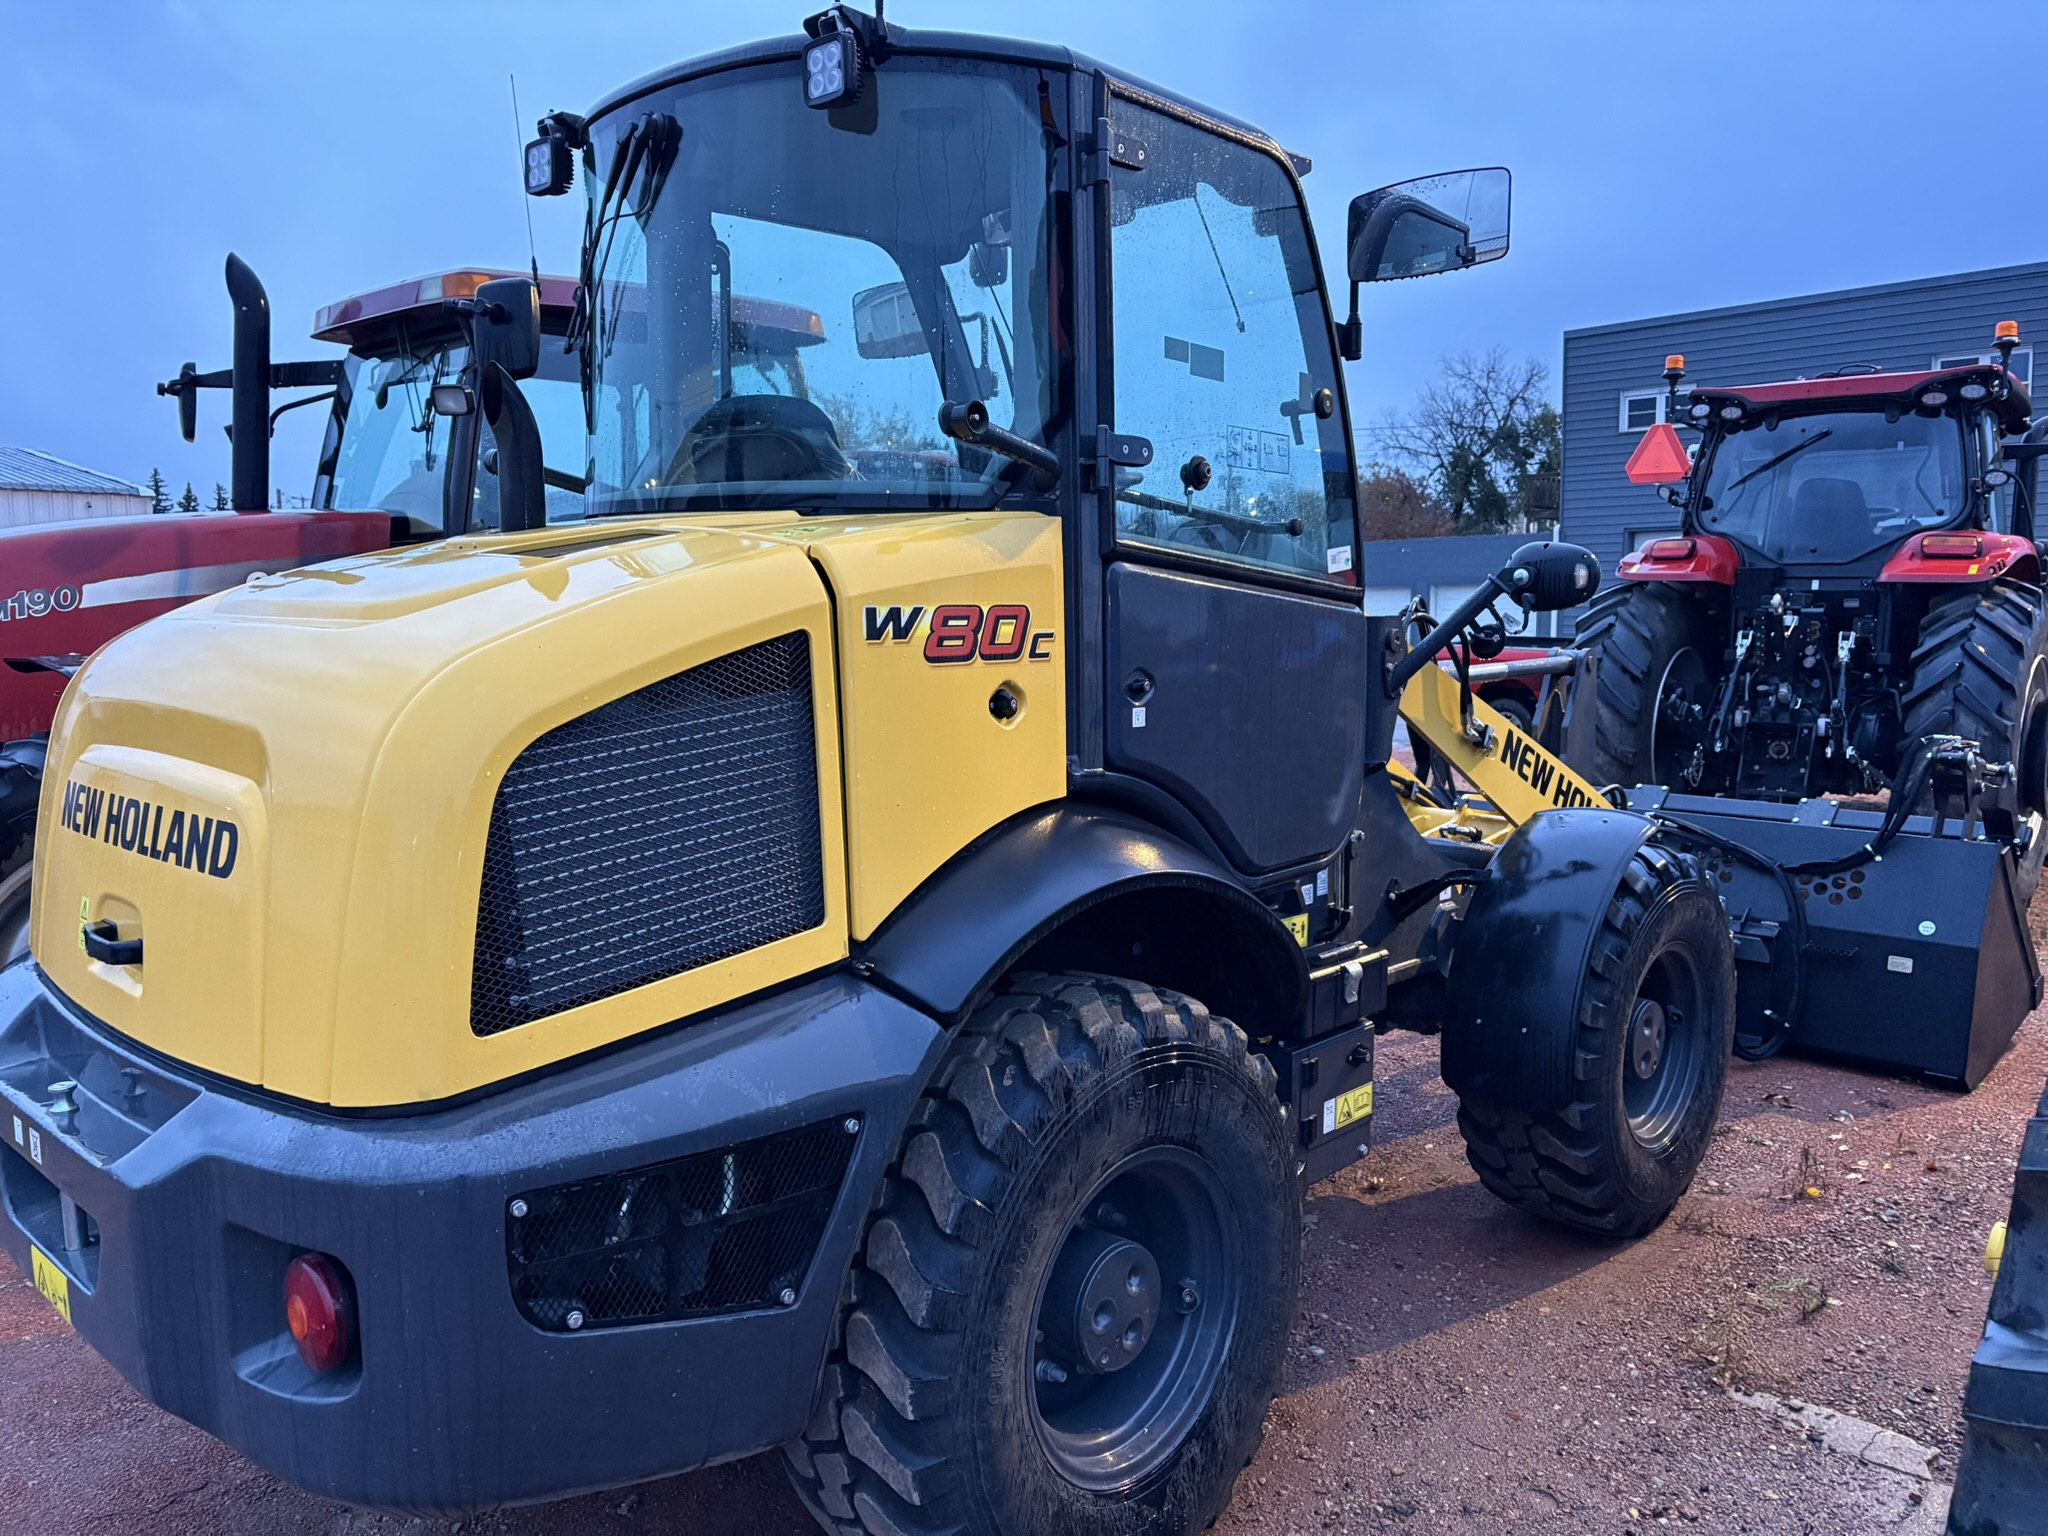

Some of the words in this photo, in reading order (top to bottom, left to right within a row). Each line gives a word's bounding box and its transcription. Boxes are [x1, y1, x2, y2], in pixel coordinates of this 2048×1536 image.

[1500, 728, 1555, 796] NEW
[61, 780, 105, 839] NEW
[103, 793, 239, 879] HOLLAND
